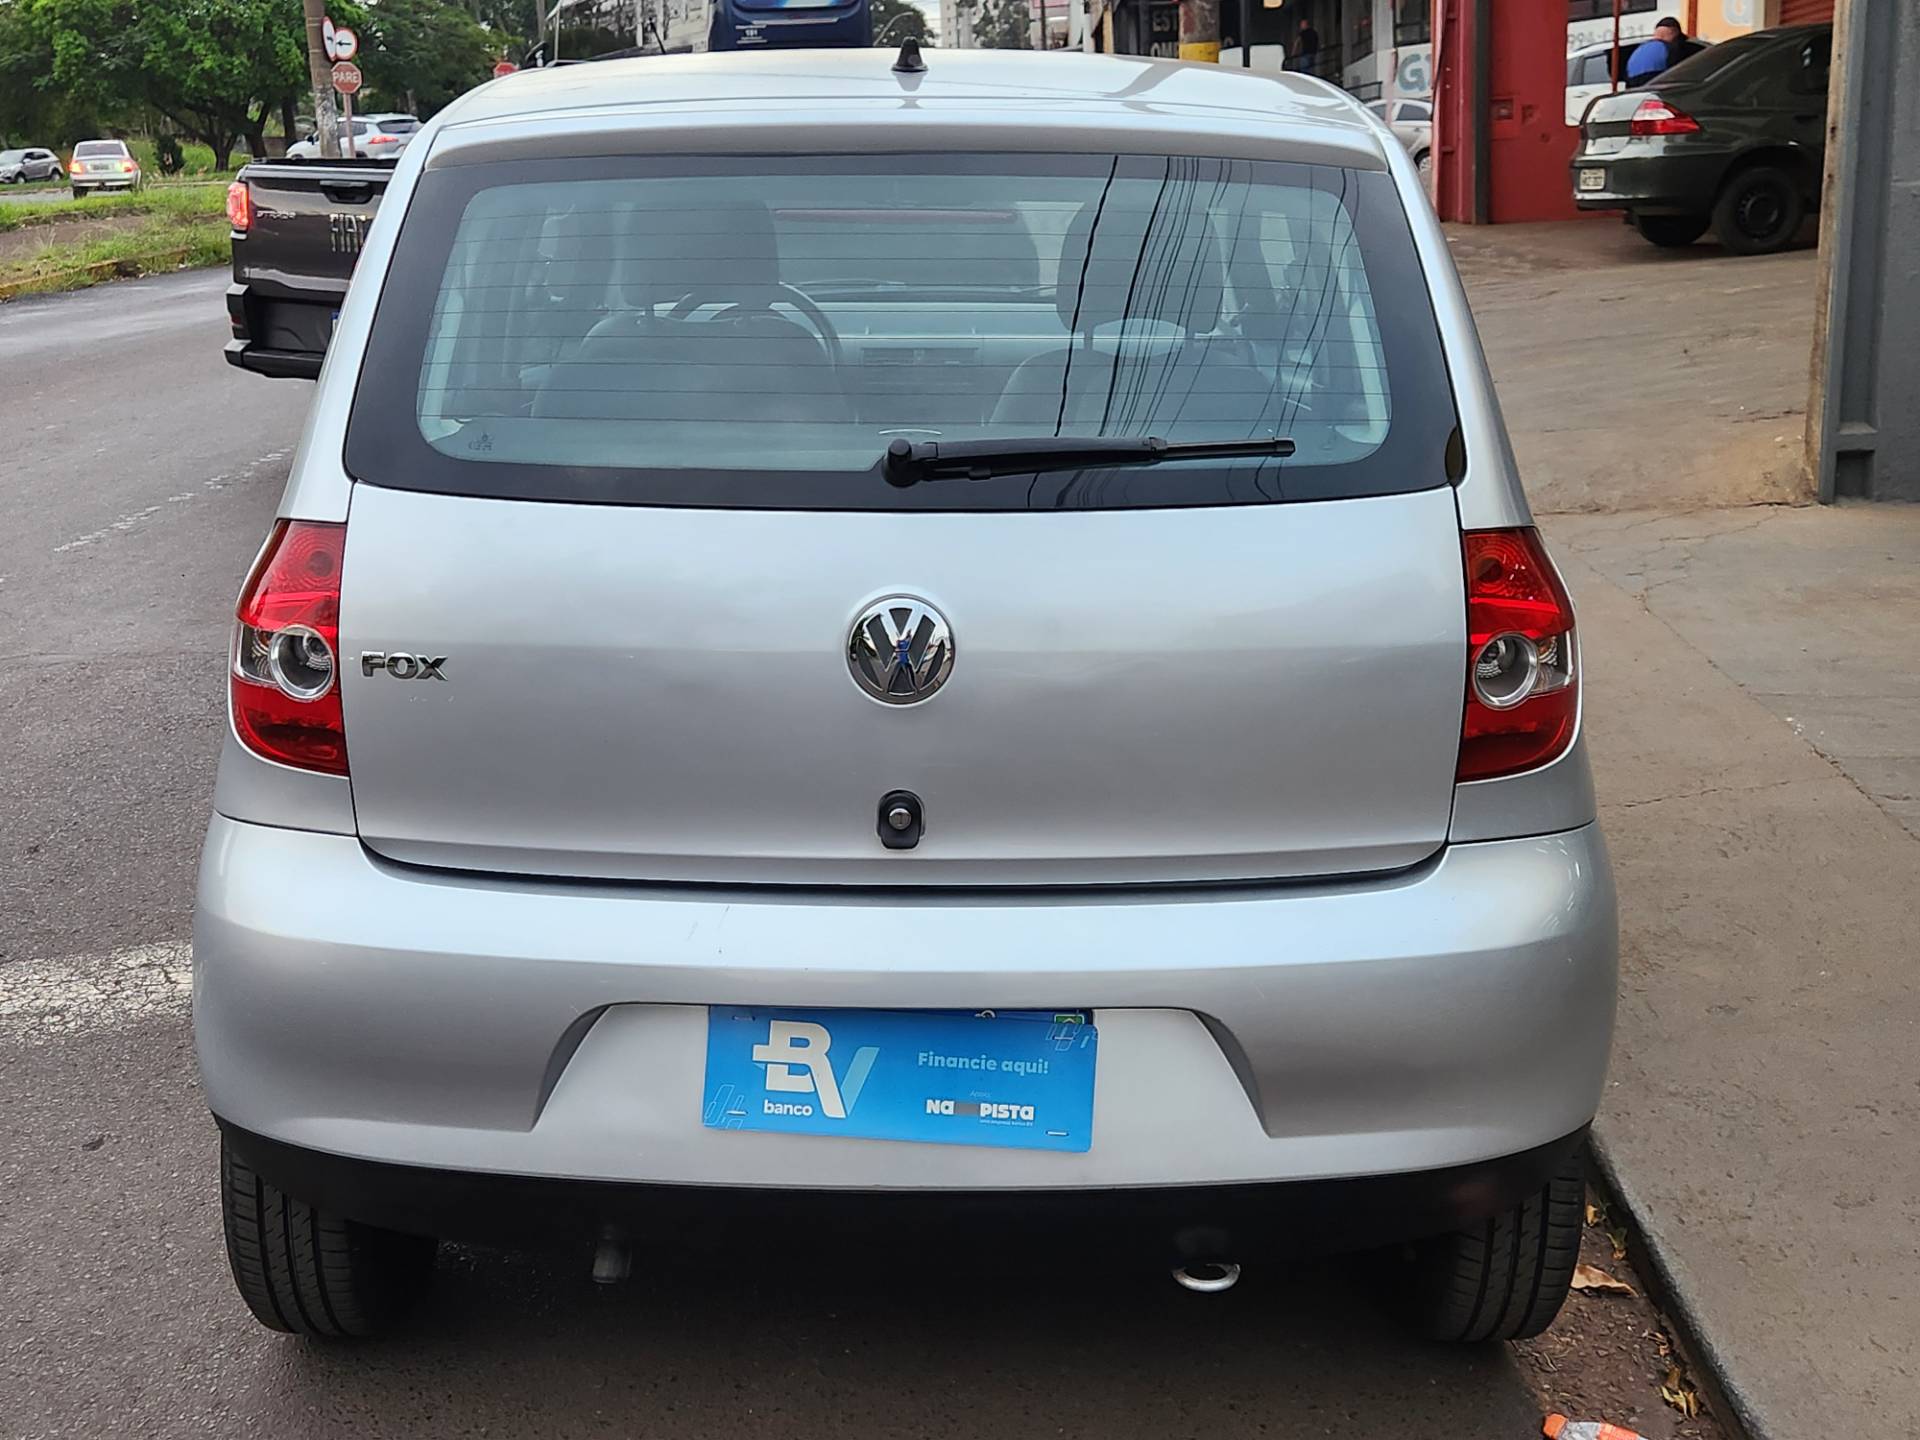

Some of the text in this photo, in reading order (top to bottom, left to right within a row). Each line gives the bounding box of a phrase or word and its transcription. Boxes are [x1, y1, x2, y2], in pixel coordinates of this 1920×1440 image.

[332, 72, 359, 83] PARE
[329, 213, 367, 252] FIAT
[361, 650, 448, 681] FOX
[918, 1052, 1048, 1076] Financie aqui!
[764, 1099, 813, 1116] banco
